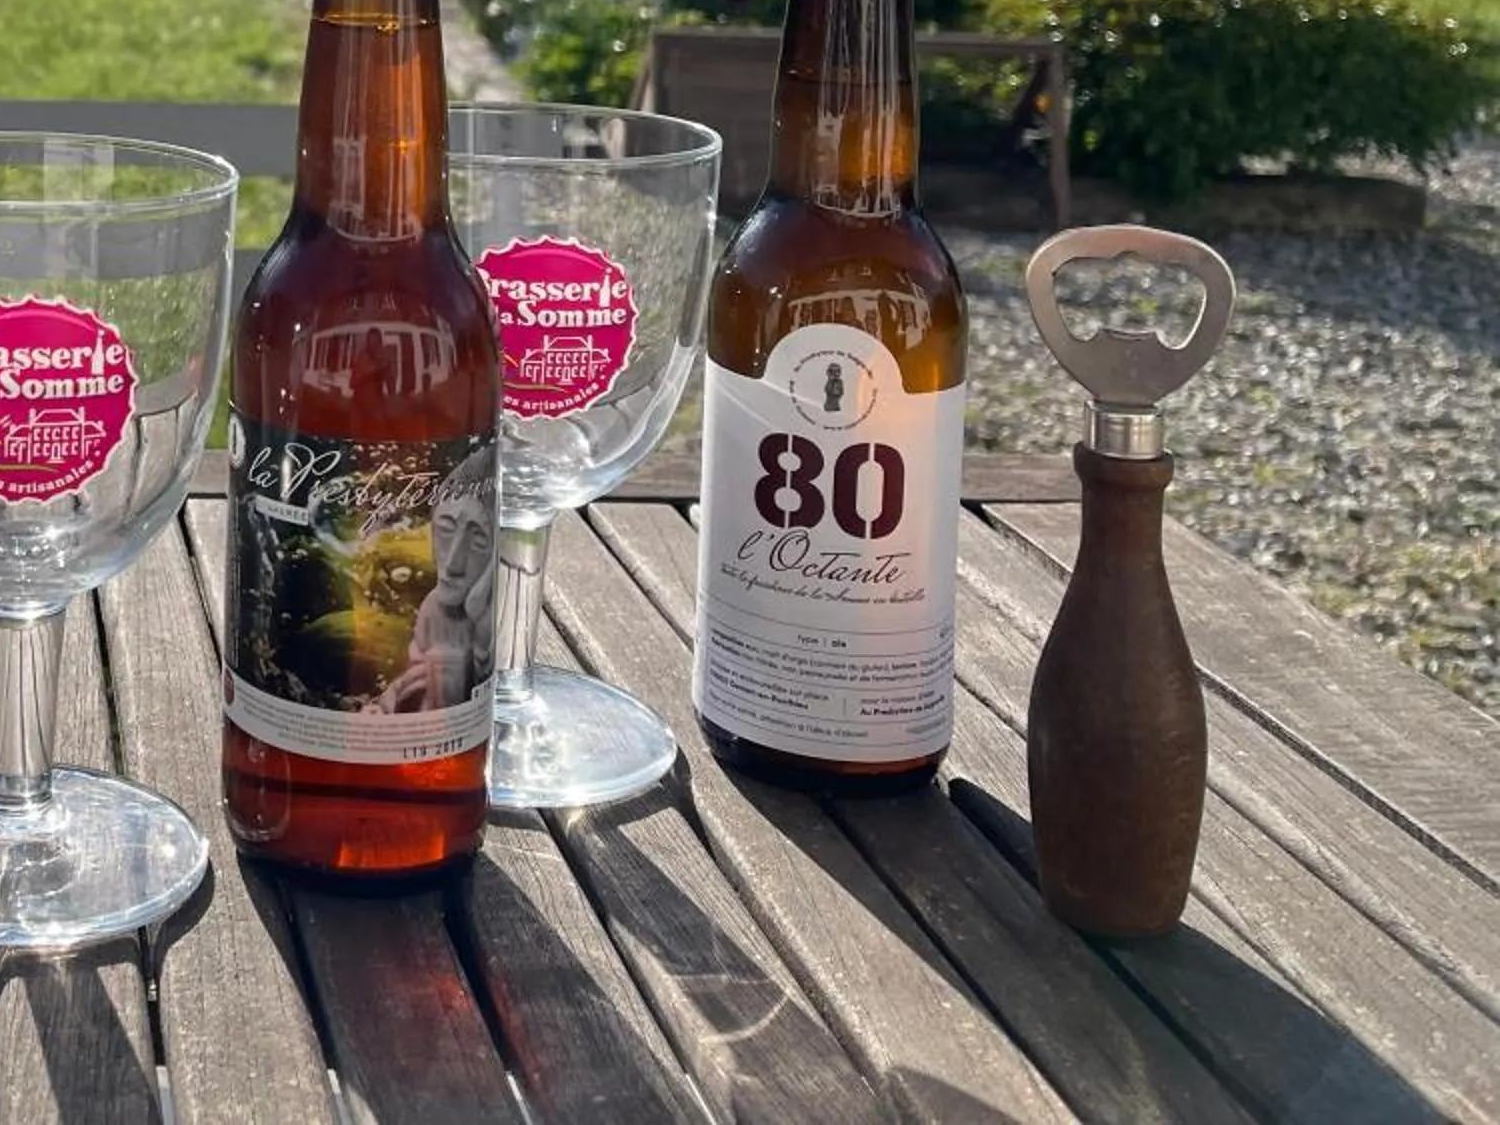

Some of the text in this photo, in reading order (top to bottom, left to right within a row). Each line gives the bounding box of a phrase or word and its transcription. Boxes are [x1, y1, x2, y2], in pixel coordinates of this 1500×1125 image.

[517, 301, 627, 327] Somme
[7, 460, 94, 494] artisanales
[754, 432, 905, 540] 80
